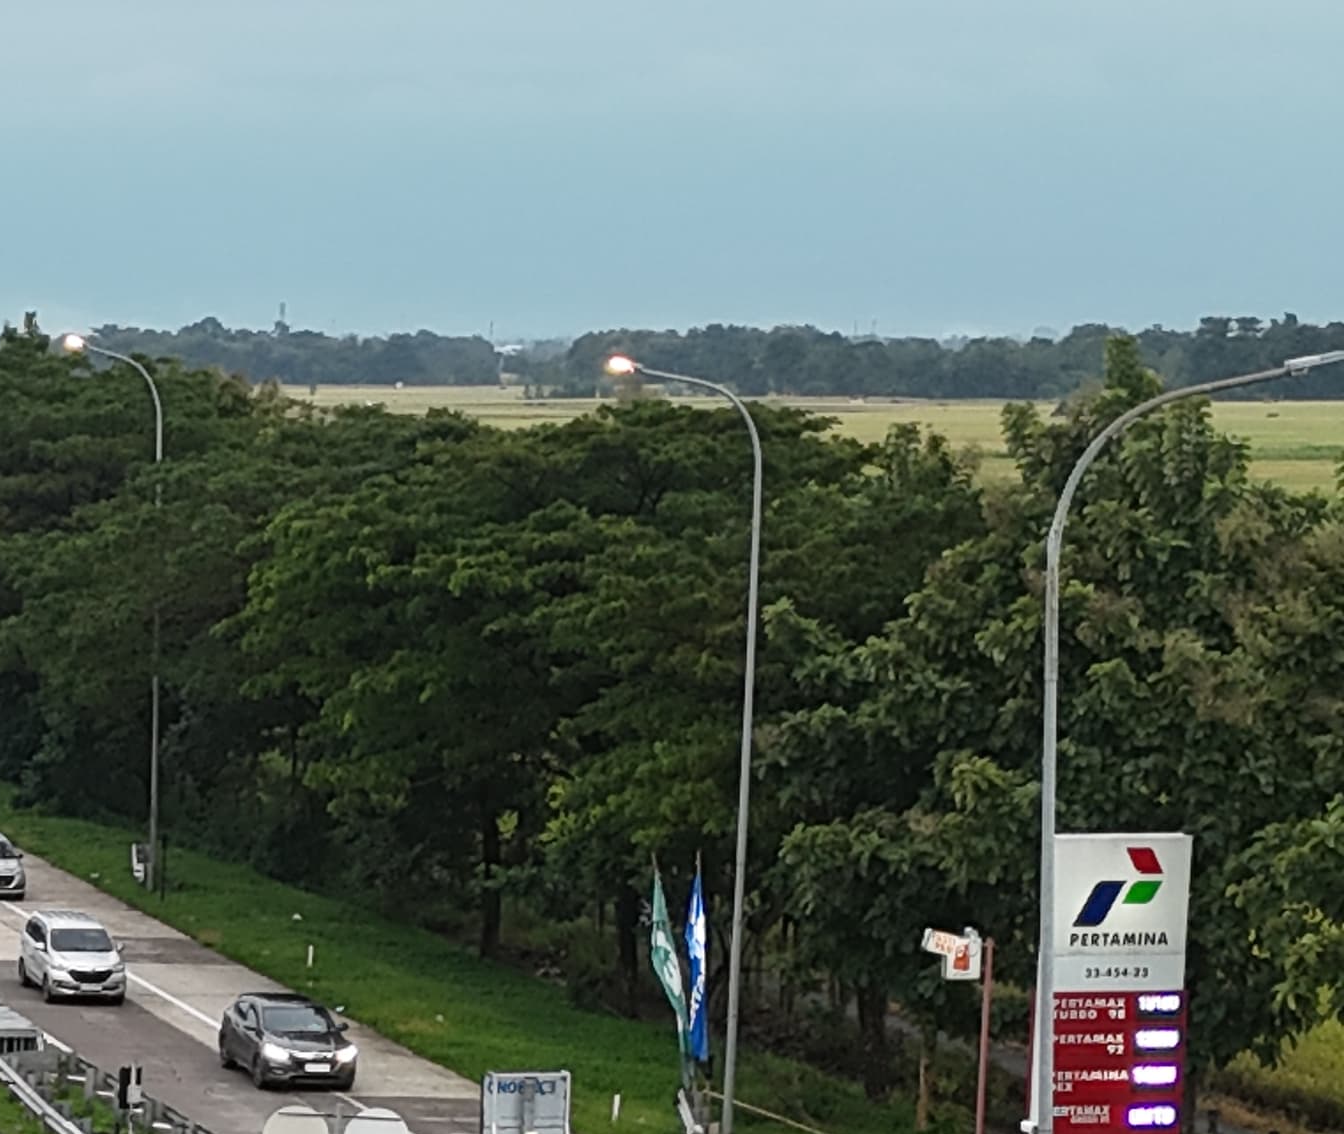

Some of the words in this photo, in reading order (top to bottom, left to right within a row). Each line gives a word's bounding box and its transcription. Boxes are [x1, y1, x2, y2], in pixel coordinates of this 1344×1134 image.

[1069, 932, 1168, 947] PERTAMINA
[1054, 1070, 1129, 1081] ERTAMINA
[1054, 1082, 1073, 1092] EX
